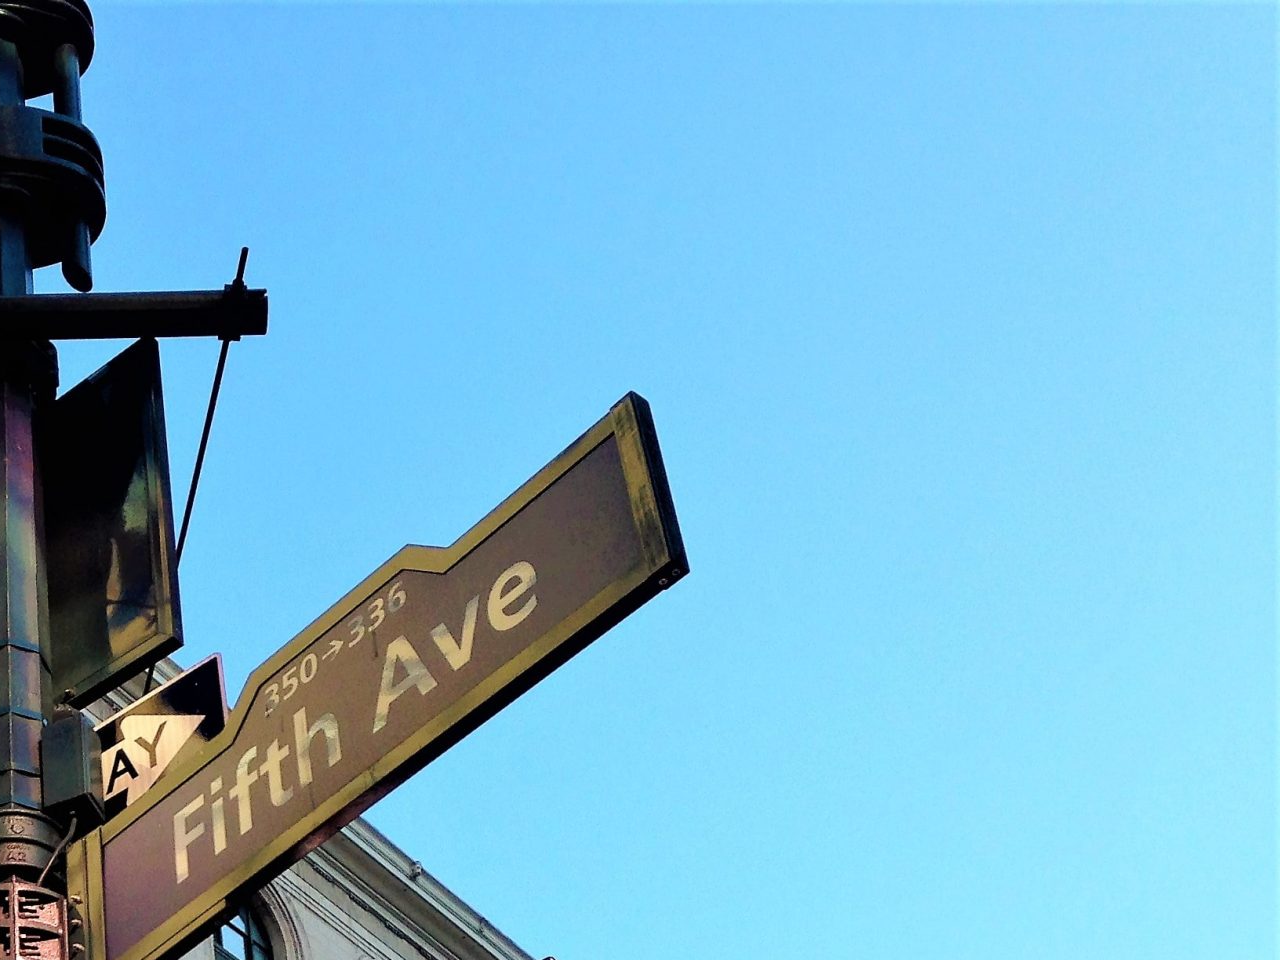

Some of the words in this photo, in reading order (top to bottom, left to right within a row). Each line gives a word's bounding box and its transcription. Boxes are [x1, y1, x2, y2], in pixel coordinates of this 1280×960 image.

[264, 653, 318, 717] 350
[349, 580, 407, 648] 336
[106, 720, 167, 796] AY
[173, 706, 342, 884] Fifth
[373, 561, 538, 734] Ave
